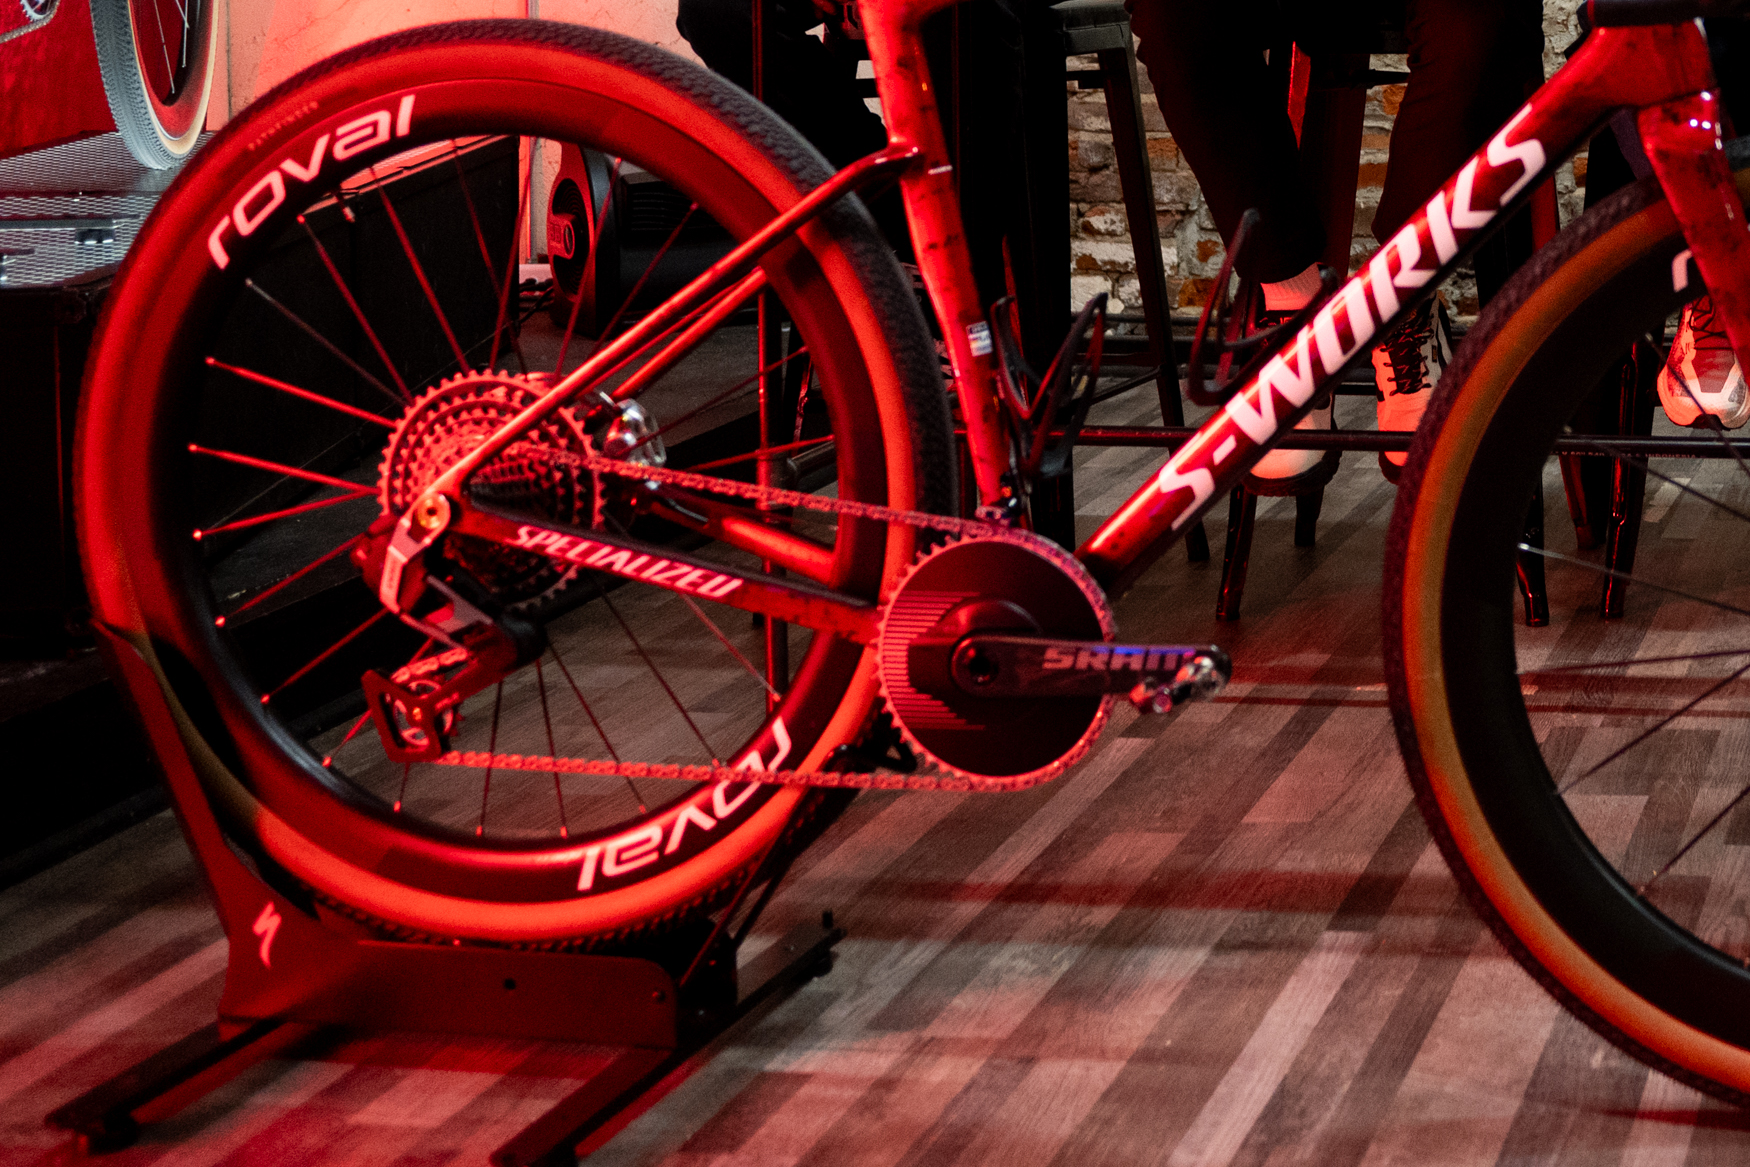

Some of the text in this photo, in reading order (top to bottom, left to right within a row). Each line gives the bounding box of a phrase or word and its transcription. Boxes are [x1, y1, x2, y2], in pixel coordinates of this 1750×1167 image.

[208, 94, 416, 270] roval
[1158, 103, 1548, 532] S-WORKS
[514, 525, 744, 598] SPECIALIZED
[577, 716, 792, 892] roval
